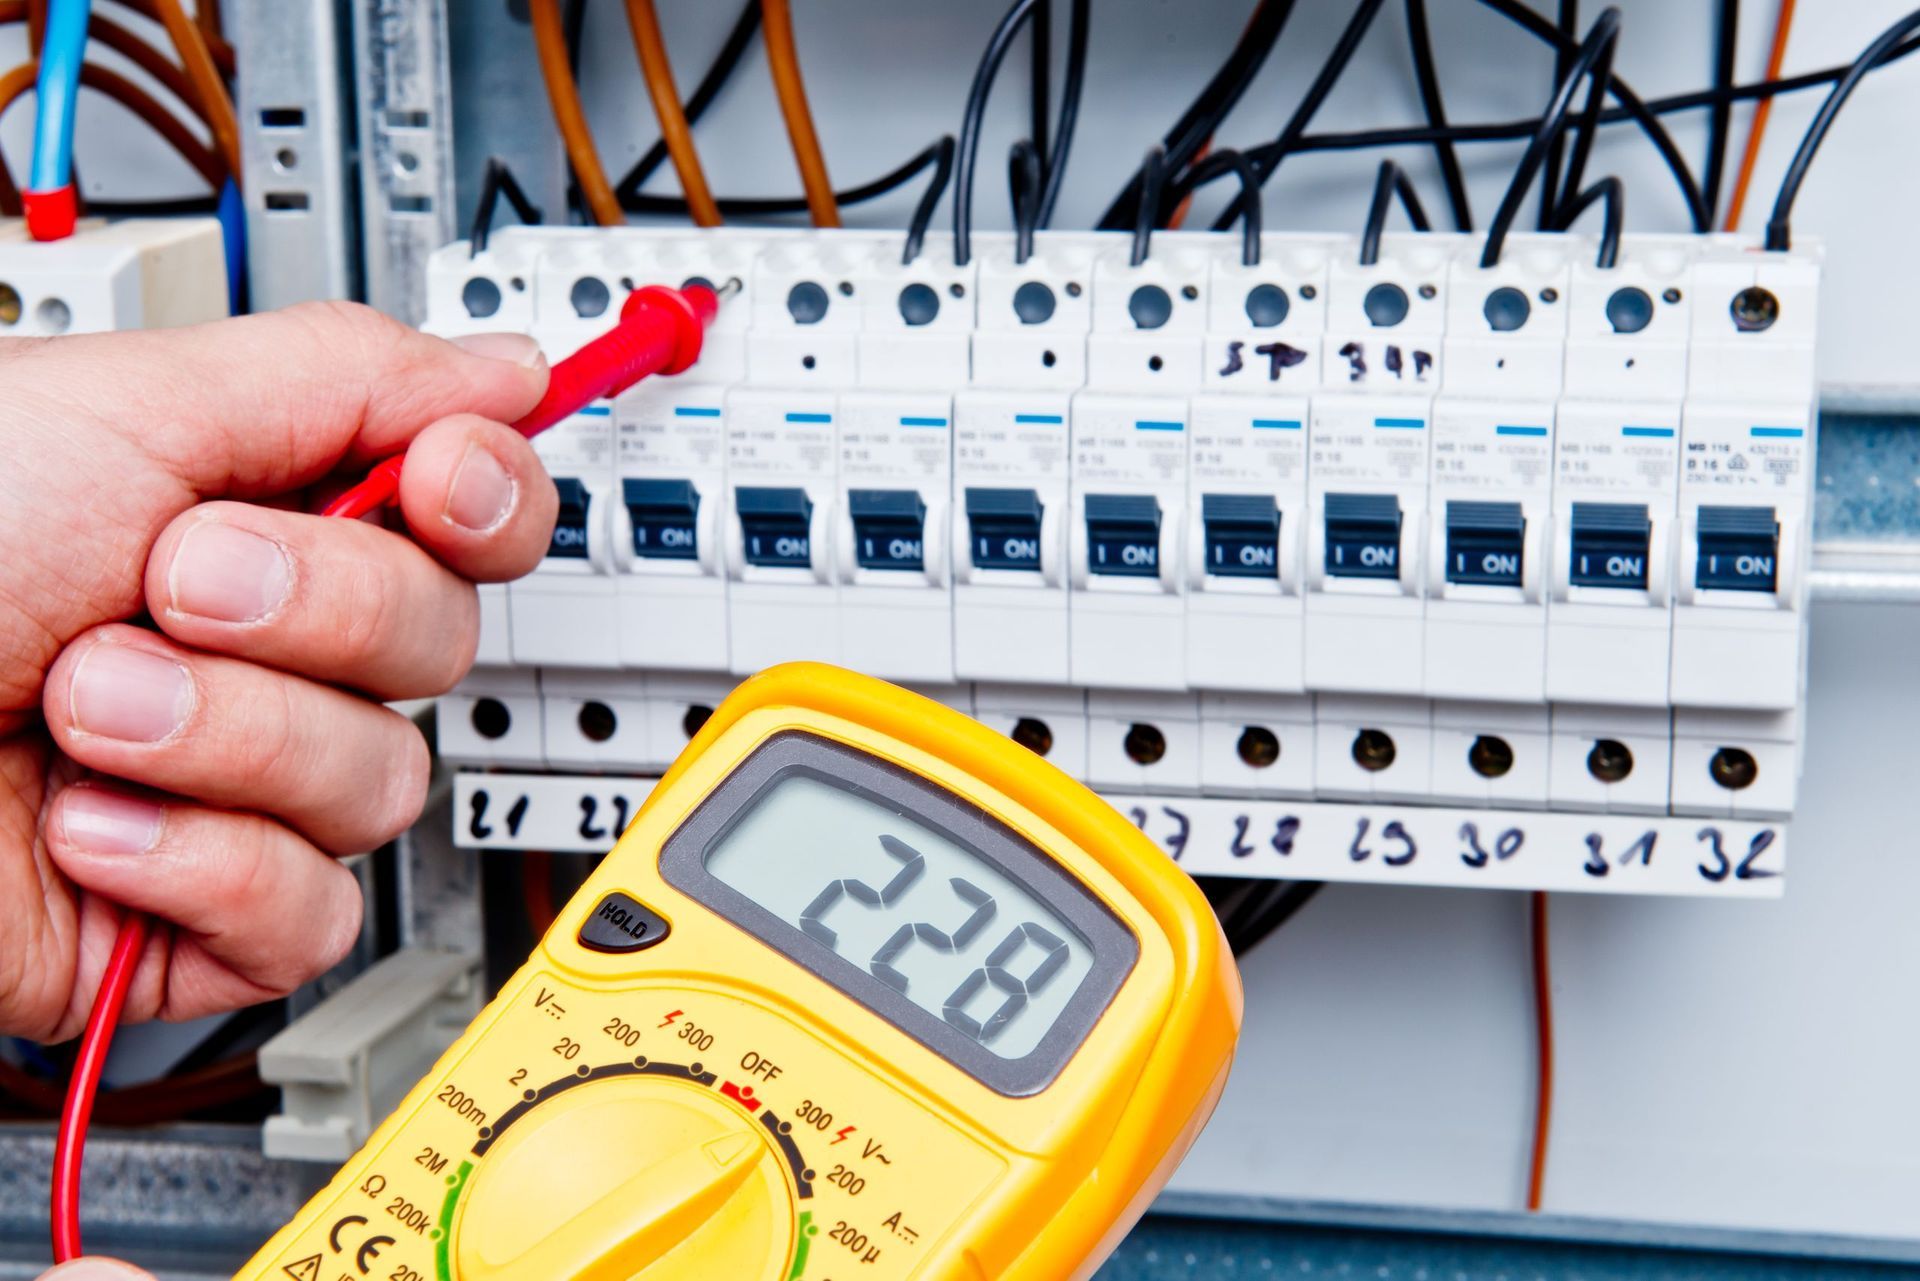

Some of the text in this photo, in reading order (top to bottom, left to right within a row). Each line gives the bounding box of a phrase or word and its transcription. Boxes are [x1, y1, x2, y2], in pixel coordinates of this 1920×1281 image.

[554, 528, 585, 544] ON
[661, 528, 692, 545] ON
[776, 538, 808, 556] ON
[890, 539, 921, 559] ON
[1005, 538, 1037, 558] ON
[1123, 545, 1155, 565] ON
[1240, 545, 1273, 565] ON
[1361, 546, 1395, 566] ON
[1483, 554, 1517, 573] ON
[1607, 556, 1641, 576] ON
[1736, 555, 1772, 575] ON
[470, 790, 529, 840] 21
[1230, 815, 1300, 858] 28
[1349, 817, 1417, 867] 29
[1460, 822, 1524, 868] 30
[1584, 832, 1659, 877] 31
[1697, 827, 1784, 882] 32
[598, 902, 648, 940] HOLD
[799, 834, 1070, 1040] 228
[603, 1017, 641, 1047] 200
[678, 1022, 714, 1052] 300
[553, 1037, 581, 1060] 20
[740, 1051, 783, 1082] OFF
[509, 1068, 528, 1087] 2
[437, 1085, 487, 1126] 200m
[795, 1100, 833, 1131] 300
[415, 1147, 449, 1175] 2M
[826, 1164, 865, 1196] 200
[385, 1196, 431, 1236] 200k
